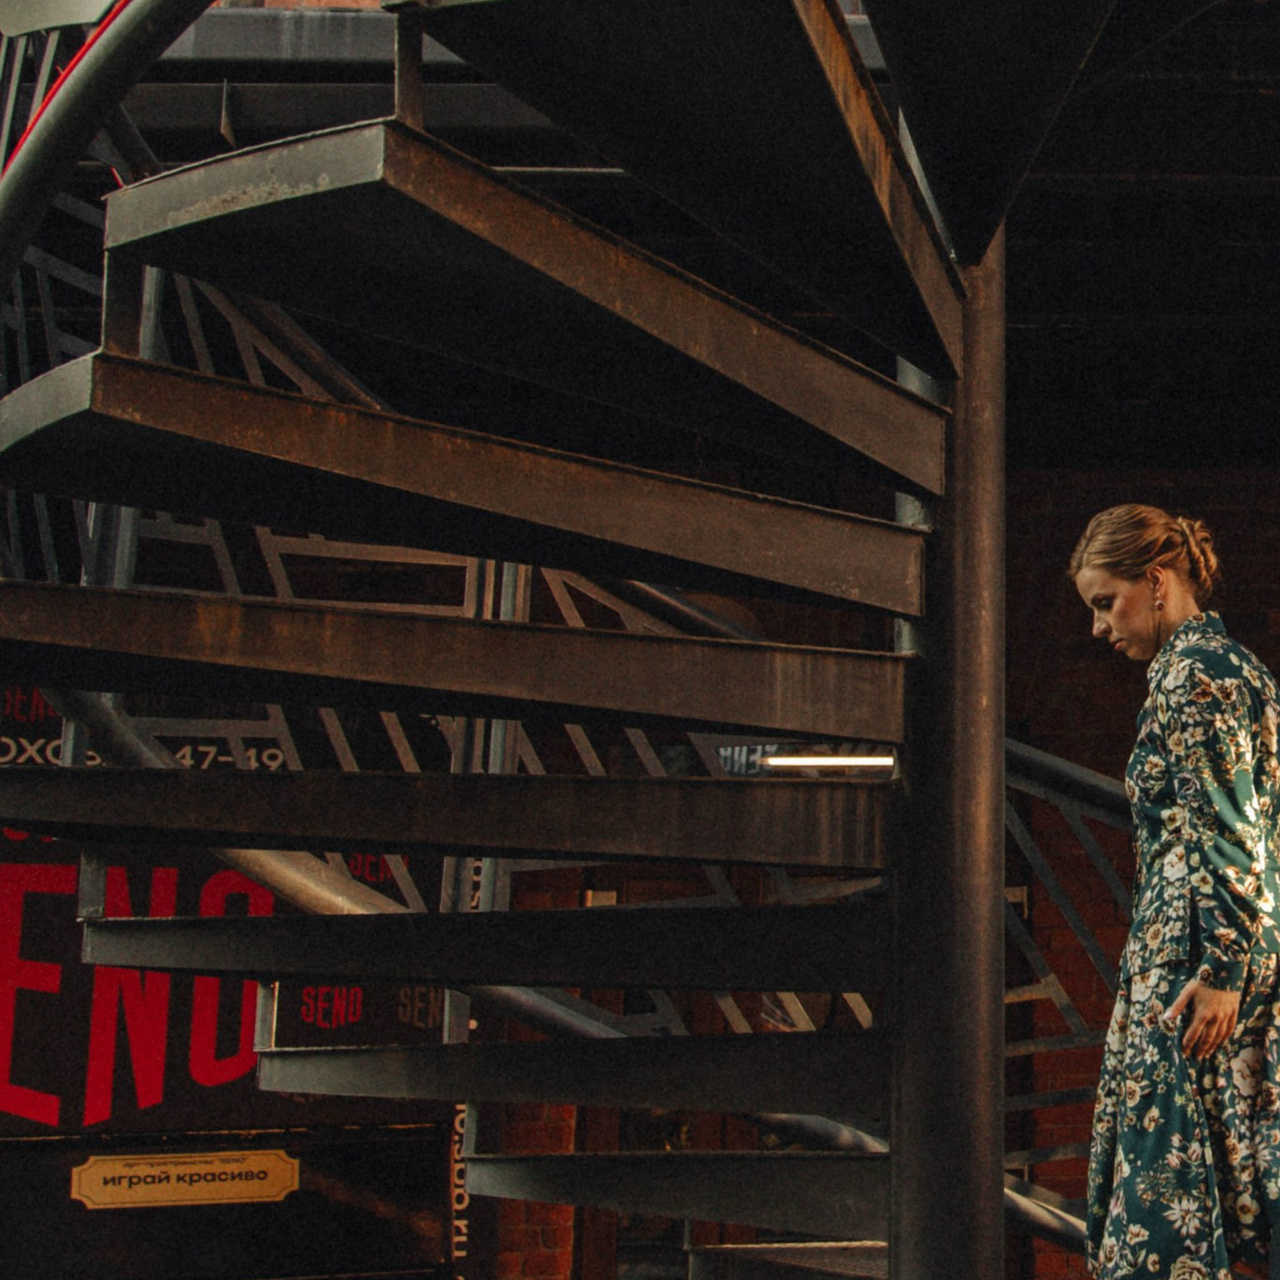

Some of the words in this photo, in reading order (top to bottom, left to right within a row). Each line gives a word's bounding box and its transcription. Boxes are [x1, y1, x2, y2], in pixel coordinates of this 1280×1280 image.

[0, 863, 274, 1127] ENO
[301, 985, 363, 1029] SENO
[398, 986, 444, 1029] SEN
[102, 1170, 171, 1189] играй
[176, 1169, 268, 1187] красиво
